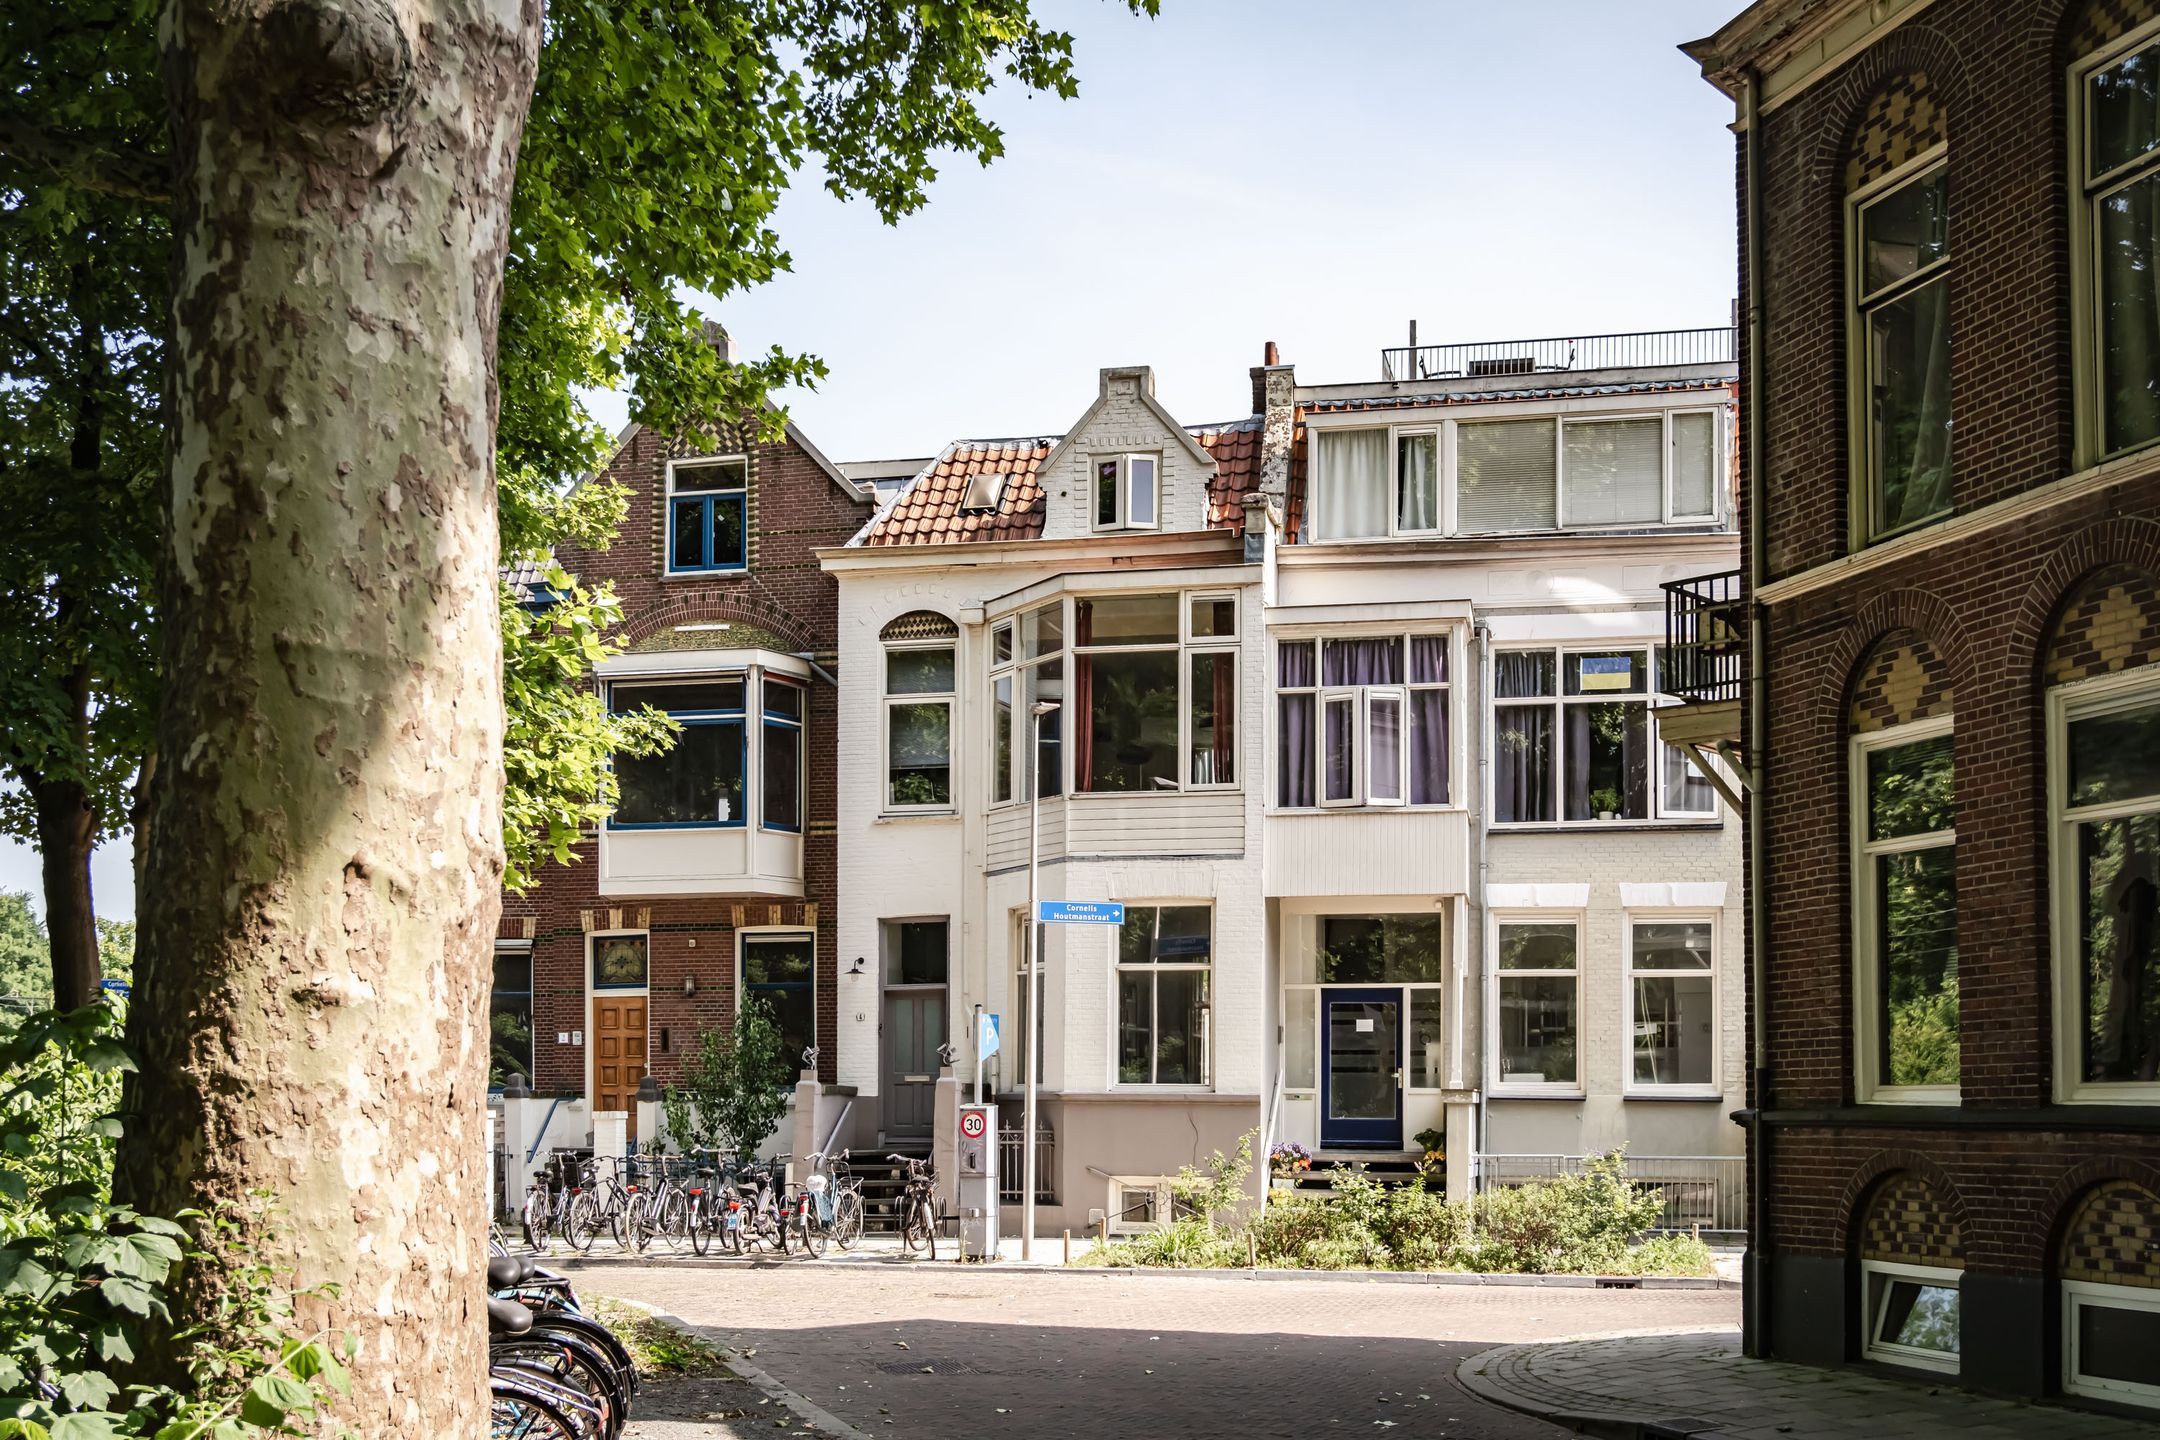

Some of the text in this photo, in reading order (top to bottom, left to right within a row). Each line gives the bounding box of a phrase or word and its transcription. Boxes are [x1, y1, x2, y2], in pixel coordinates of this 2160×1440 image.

[1066, 904, 1097, 912] Cornelis
[1053, 912, 1110, 921] Houtmanstraat
[986, 1027, 994, 1045] P
[966, 1118, 982, 1131] 30
